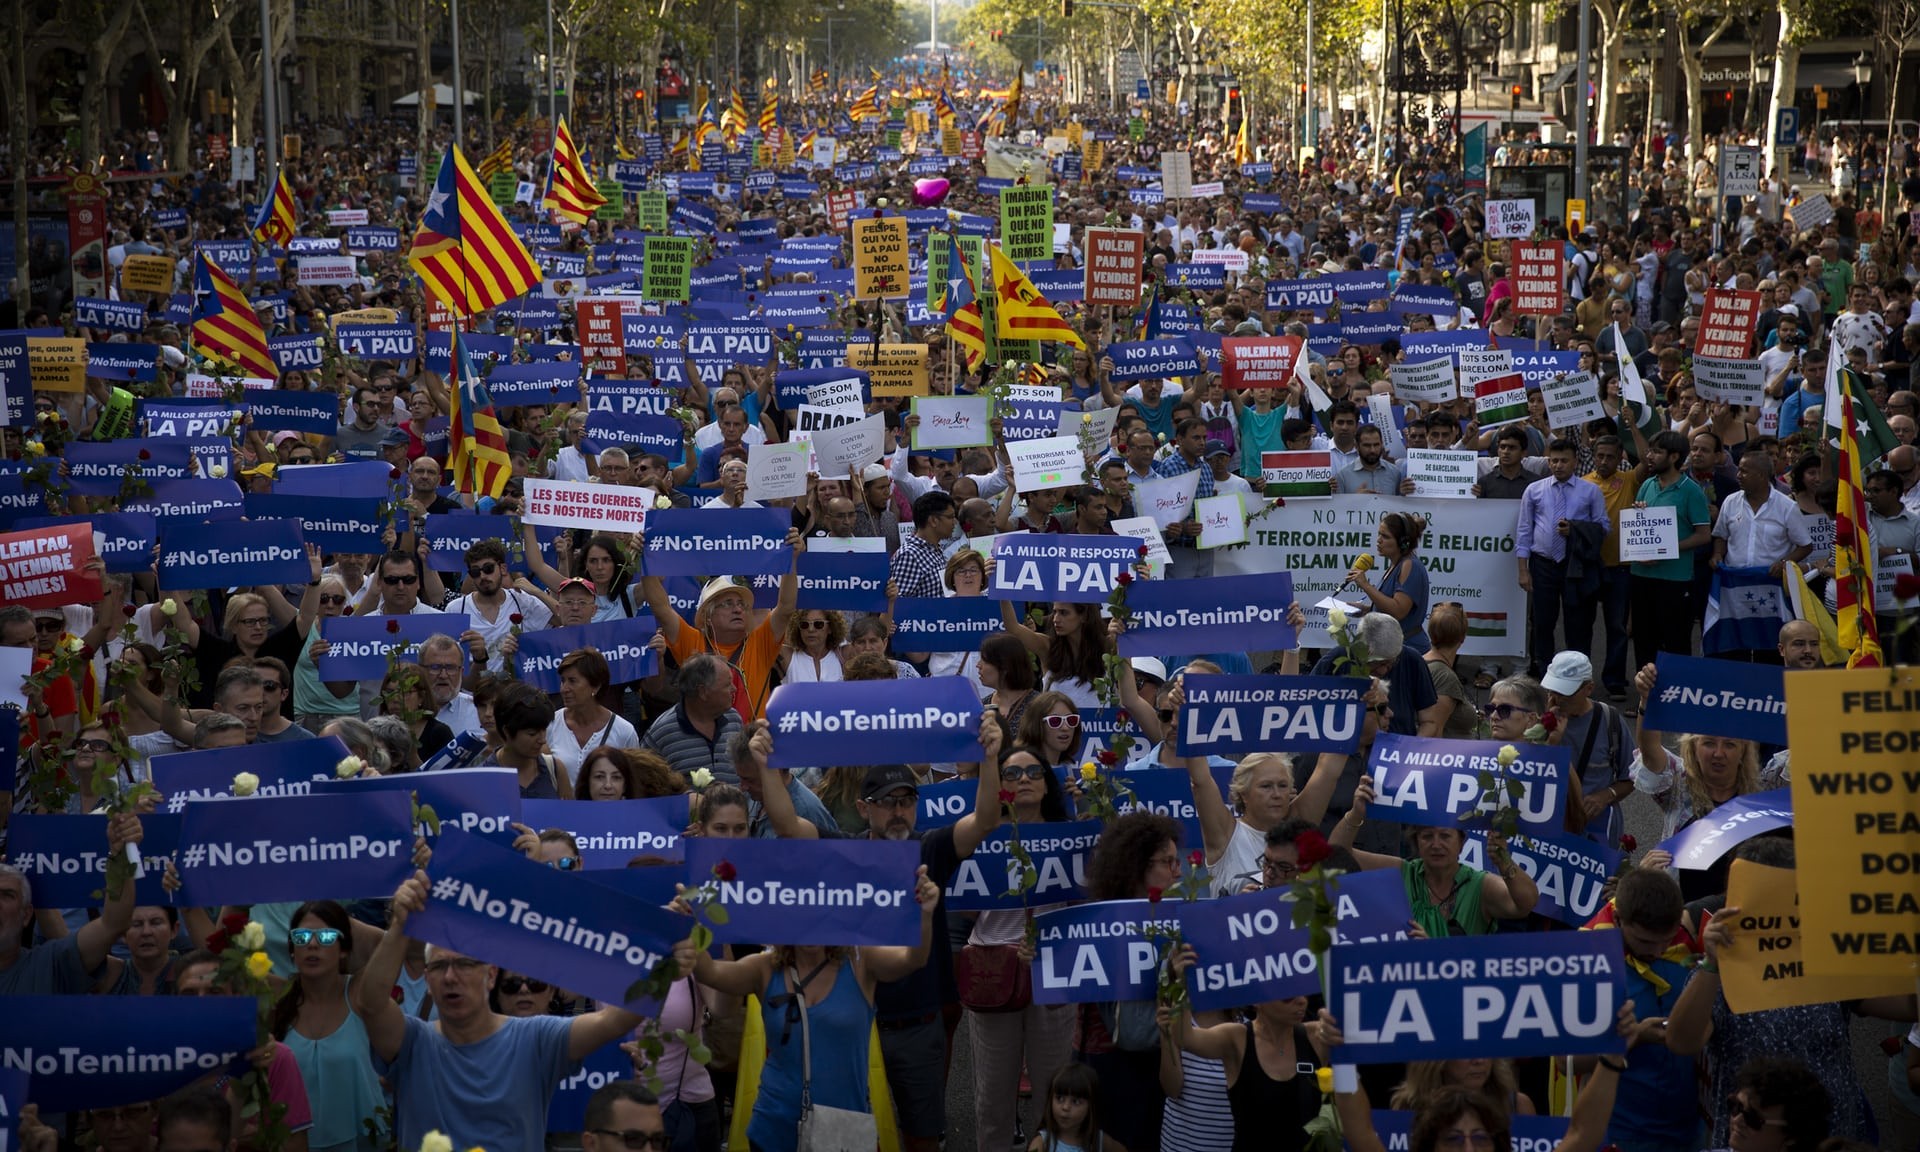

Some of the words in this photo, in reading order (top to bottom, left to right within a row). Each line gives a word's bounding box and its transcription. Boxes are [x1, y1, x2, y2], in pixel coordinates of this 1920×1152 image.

[1780, 112, 1794, 140] P
[1005, 191, 1048, 203] IMAGINA
[1008, 206, 1021, 217] UN
[1023, 205, 1046, 217] PAÍS
[1010, 219, 1029, 232] QUE
[1031, 219, 1045, 230] NO
[369, 236, 397, 248] PAU
[649, 240, 688, 251] IMAGINA
[861, 235, 880, 244] QUI
[881, 234, 901, 243] VOL
[1008, 233, 1045, 246] VENGUI
[1097, 239, 1135, 252] VOLEM
[864, 245, 876, 254] LA
[879, 244, 900, 253] PAU
[1010, 246, 1044, 258] ARMES
[1520, 249, 1555, 260] VOLEM
[650, 253, 662, 263] UN
[664, 252, 685, 263] PAÍS
[874, 255, 889, 263] NO
[1120, 256, 1135, 268] NO
[651, 265, 668, 274] QUE
[670, 265, 682, 275] NO
[862, 264, 904, 274] TRAFICA
[1541, 265, 1555, 276] NO
[649, 276, 682, 286] VENGUI
[872, 275, 895, 283] AMB
[1092, 273, 1136, 285] VENDRE
[650, 288, 681, 298] ARMES
[1517, 281, 1557, 292] VENDRE
[1092, 287, 1135, 300] ARMES!
[1299, 290, 1334, 305] PAU
[1517, 297, 1557, 308] ARMES!
[1714, 297, 1751, 310] VOLEM
[593, 305, 605, 316] WE
[77, 308, 98, 322] LA
[104, 310, 141, 329] PAU
[589, 320, 611, 330] WANT
[1709, 312, 1731, 326] PAU,
[1734, 314, 1748, 326] NO
[628, 324, 645, 334] NO
[648, 325, 658, 334] A
[660, 325, 674, 335] LA
[1341, 323, 1401, 335] #NoTenimPor
[1704, 328, 1747, 342] VENDRE
[588, 333, 615, 343] PEACE,
[688, 337, 718, 354] LA
[724, 335, 770, 354] PAU
[340, 339, 368, 354] LA
[372, 337, 414, 354] PAU
[601, 347, 622, 356] ARMS
[1235, 346, 1268, 358] VOLEM
[1406, 341, 1487, 354] #NoTenimPor
[1701, 345, 1743, 357] ARMES!
[280, 349, 323, 367] PAU
[1126, 348, 1148, 359] NO
[1150, 348, 1160, 357] A
[1163, 346, 1179, 357] LA
[1462, 354, 1480, 362] TOTS
[1482, 354, 1504, 362] SOM
[1112, 359, 1198, 376] ISLAMOFÒBIA
[1236, 360, 1250, 370] NO
[1251, 359, 1289, 371] VENDRE
[1461, 364, 1510, 373] BARCELONA
[1243, 370, 1282, 381] ARMES!
[489, 378, 574, 393] #NoTenimPor
[597, 387, 626, 395] MILLOR
[629, 386, 670, 395] RESPOSTA
[809, 387, 828, 399] TOTS
[830, 384, 852, 393] SOM
[248, 404, 332, 420] #NoTenimPor
[586, 397, 613, 413] LA
[621, 396, 670, 415] PAU
[587, 427, 678, 447] #NoTenimPor
[1026, 451, 1062, 461] TERRORISME
[1045, 457, 1066, 467] RELIGIÓ
[1417, 453, 1441, 461] COMUNITAT
[1442, 454, 1474, 462] PAKISTANESA
[1263, 470, 1275, 480] No
[1278, 470, 1303, 482] Tengo
[1306, 469, 1331, 479] Miedo
[1444, 475, 1474, 483] TERRORISME
[533, 488, 553, 500] LES
[555, 490, 589, 504] SEVES
[592, 492, 644, 510] GUERRES,
[531, 502, 550, 514] ELS
[553, 504, 602, 520] NOSTRES
[606, 508, 643, 523] MORTS
[1313, 510, 1336, 523] NO
[1636, 512, 1646, 520] EL
[1621, 519, 1673, 528] TERRORISME
[1643, 527, 1655, 536] TÉ
[39, 534, 73, 552] PAU,
[649, 535, 785, 552] #NoTenimPor
[1256, 531, 1371, 548] TERRORISME
[1439, 533, 1514, 553] RELIGIÓ
[1626, 535, 1662, 546] RELIGIÓ
[163, 546, 301, 567] #NoTenimPor
[997, 546, 1013, 555] LA
[1016, 546, 1067, 558] MILLOR
[1070, 548, 1137, 559] RESPOSTA
[9, 552, 74, 579] VENDRE
[1286, 554, 1338, 570] ISLAM
[995, 560, 1044, 591] LA
[1057, 561, 1138, 593] PAU
[4, 575, 67, 600] ARMES!
[1188, 688, 1208, 703] LA
[1213, 688, 1274, 703] MILLOR
[1278, 686, 1359, 701] RESPOSTA
[778, 706, 972, 735] #NoTenimPor
[1186, 705, 1244, 746] LA
[1258, 703, 1358, 742] PAU
[1381, 747, 1400, 762] LA
[1403, 750, 1467, 769] MILLOR
[1808, 772, 1894, 795] WHO
[1374, 765, 1429, 811] LA
[1445, 774, 1558, 823] PAU
[926, 795, 966, 818] NO
[182, 836, 404, 869] #NoTenimPor
[699, 880, 908, 908] #NoTenimPor
[432, 876, 663, 972] #NoTenimPor
[1228, 910, 1279, 941] NO
[1740, 915, 1782, 930] QUI
[1041, 925, 1062, 940] LA
[1067, 920, 1137, 940] MILLOR
[1758, 936, 1792, 952] NO
[1041, 943, 1110, 989] LA
[1343, 965, 1376, 985] LA
[1381, 959, 1477, 983] MILLOR
[1484, 953, 1612, 979] RESPOSTA
[1343, 987, 1436, 1045] LA
[1462, 981, 1613, 1040] PAU
[0, 1046, 238, 1076] NoTenimPor
